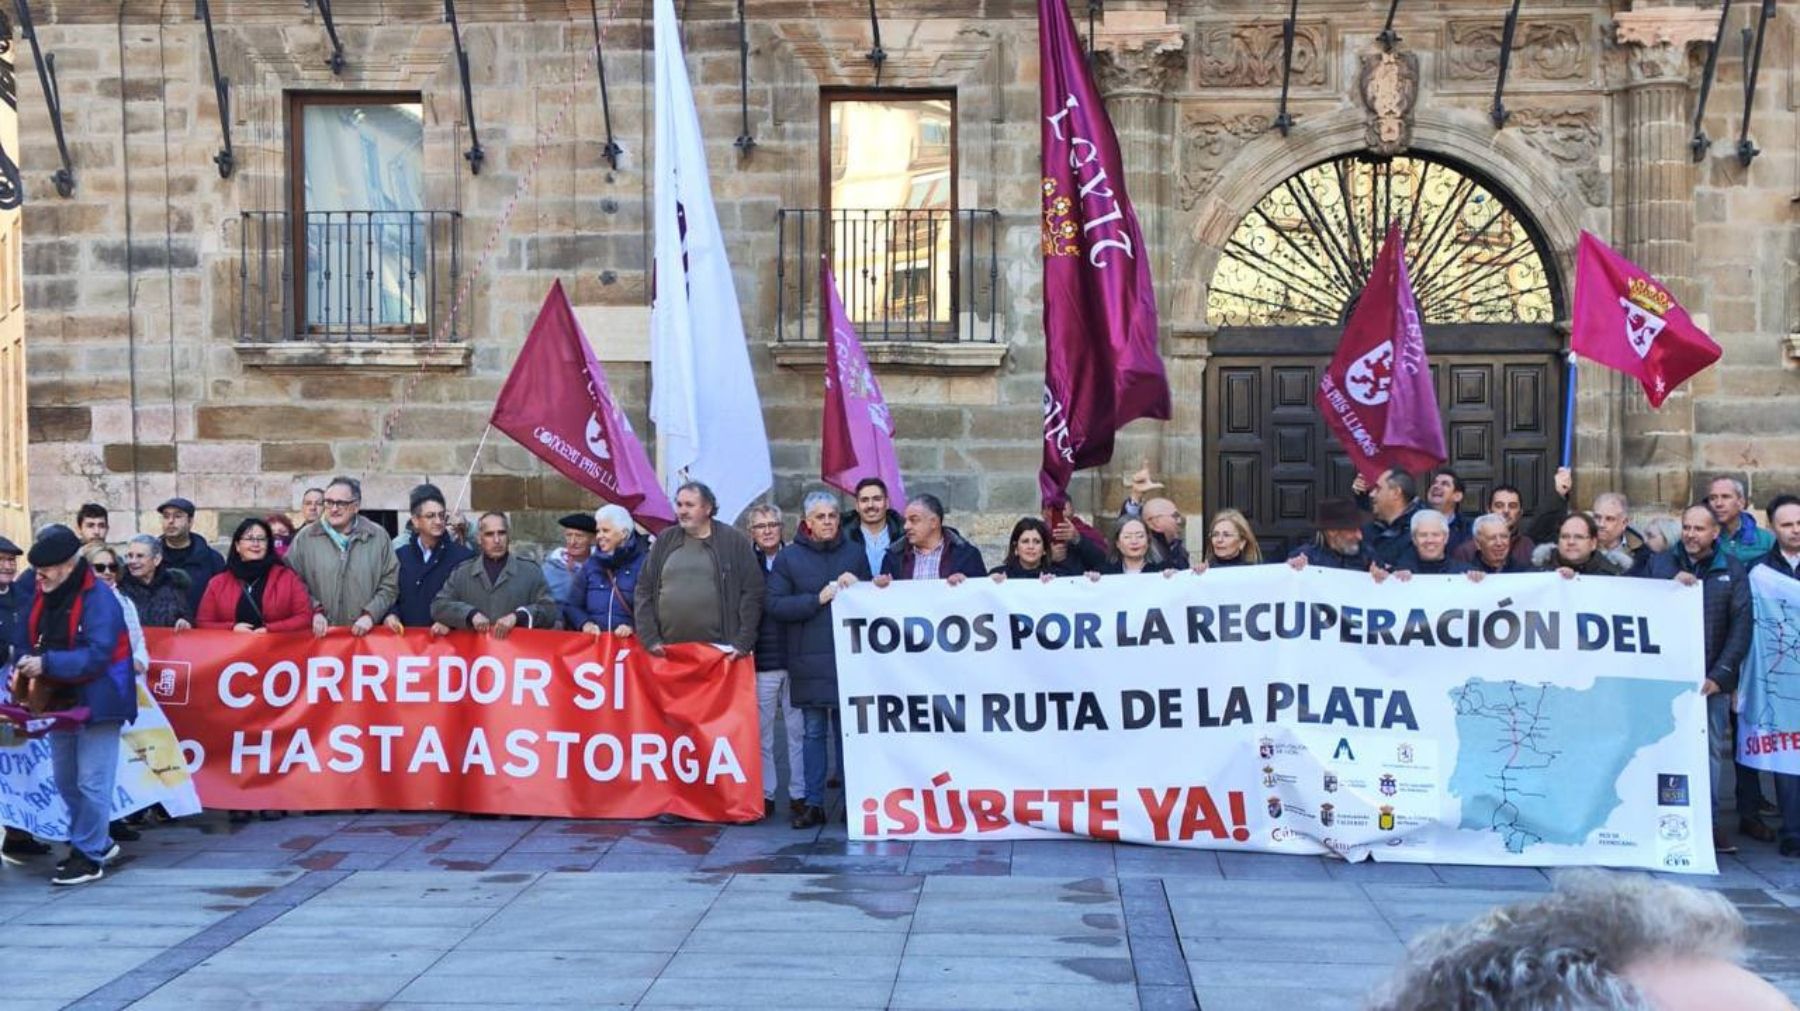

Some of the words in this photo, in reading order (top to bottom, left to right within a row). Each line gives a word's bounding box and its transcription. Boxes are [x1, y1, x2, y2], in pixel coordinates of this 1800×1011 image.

[842, 613, 998, 655] TODOS
[1009, 612, 1103, 651] POR
[1116, 608, 1175, 648] LA
[1187, 597, 1560, 650] RECUPERACIÓN
[1576, 612, 1661, 655] DEL
[218, 654, 552, 708] CORREDOR
[573, 649, 631, 710] SÍ
[847, 693, 966, 735] TREN
[982, 691, 1110, 733] RUTA
[1121, 688, 1183, 730] DE
[1197, 686, 1253, 728] LA
[1266, 682, 1419, 731] PLATA
[230, 724, 450, 774] HASTA
[461, 727, 748, 785] ASTORGA
[861, 771, 1119, 841] ¡SÚBETE
[1137, 787, 1249, 842] YA!
